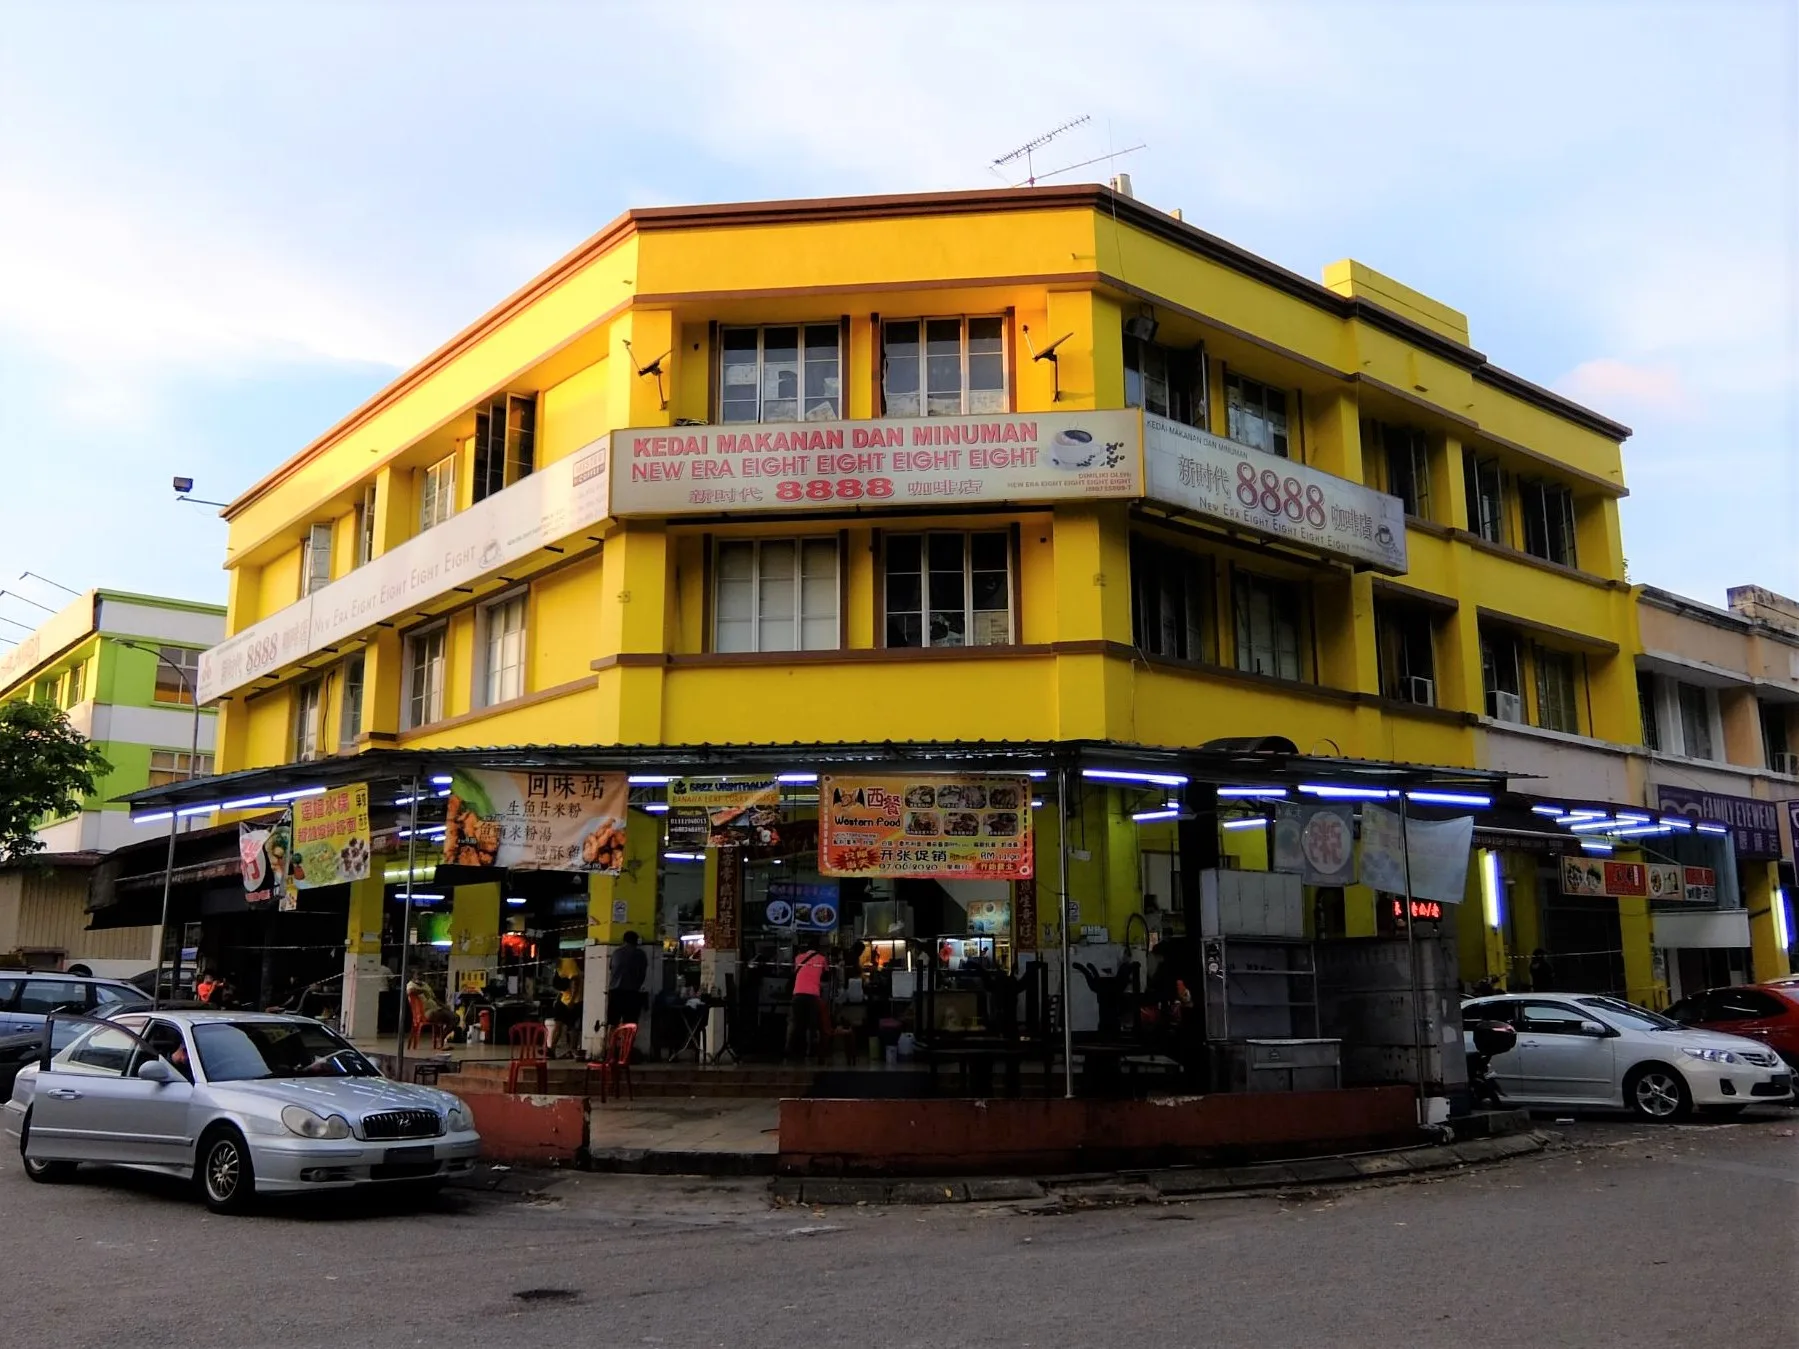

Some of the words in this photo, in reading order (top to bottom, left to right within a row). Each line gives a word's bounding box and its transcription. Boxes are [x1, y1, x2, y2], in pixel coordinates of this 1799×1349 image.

[632, 435, 708, 457] KEDAI
[716, 429, 844, 454] MAKANAN
[852, 427, 903, 448] DAN
[912, 422, 1038, 446] MINUMAN
[1146, 419, 1168, 433] KEDAI
[1169, 426, 1202, 444] MAKANAN
[1203, 438, 1217, 449] DAN
[631, 461, 685, 482] NEW
[691, 459, 735, 480] ERA
[742, 455, 810, 477] EIGHT
[816, 452, 886, 474] EIGHT
[892, 450, 962, 472] EIGHT
[969, 447, 1039, 469] EIGHT
[689, 487, 763, 504] 新时代
[775, 478, 895, 502] 8888
[907, 479, 983, 496] 咖啡店
[1236, 461, 1328, 530] 8888
[246, 632, 278, 674] 8888
[527, 773, 606, 800] 回味站
[507, 800, 582, 818] 生魚片米粉
[867, 787, 900, 816] 西餐
[1702, 796, 1735, 826] FAMILY
[1736, 801, 1777, 831] EYEWEAR
[834, 815, 874, 827] Western
[880, 850, 947, 861] 开张促销
[980, 851, 995, 860] RM
